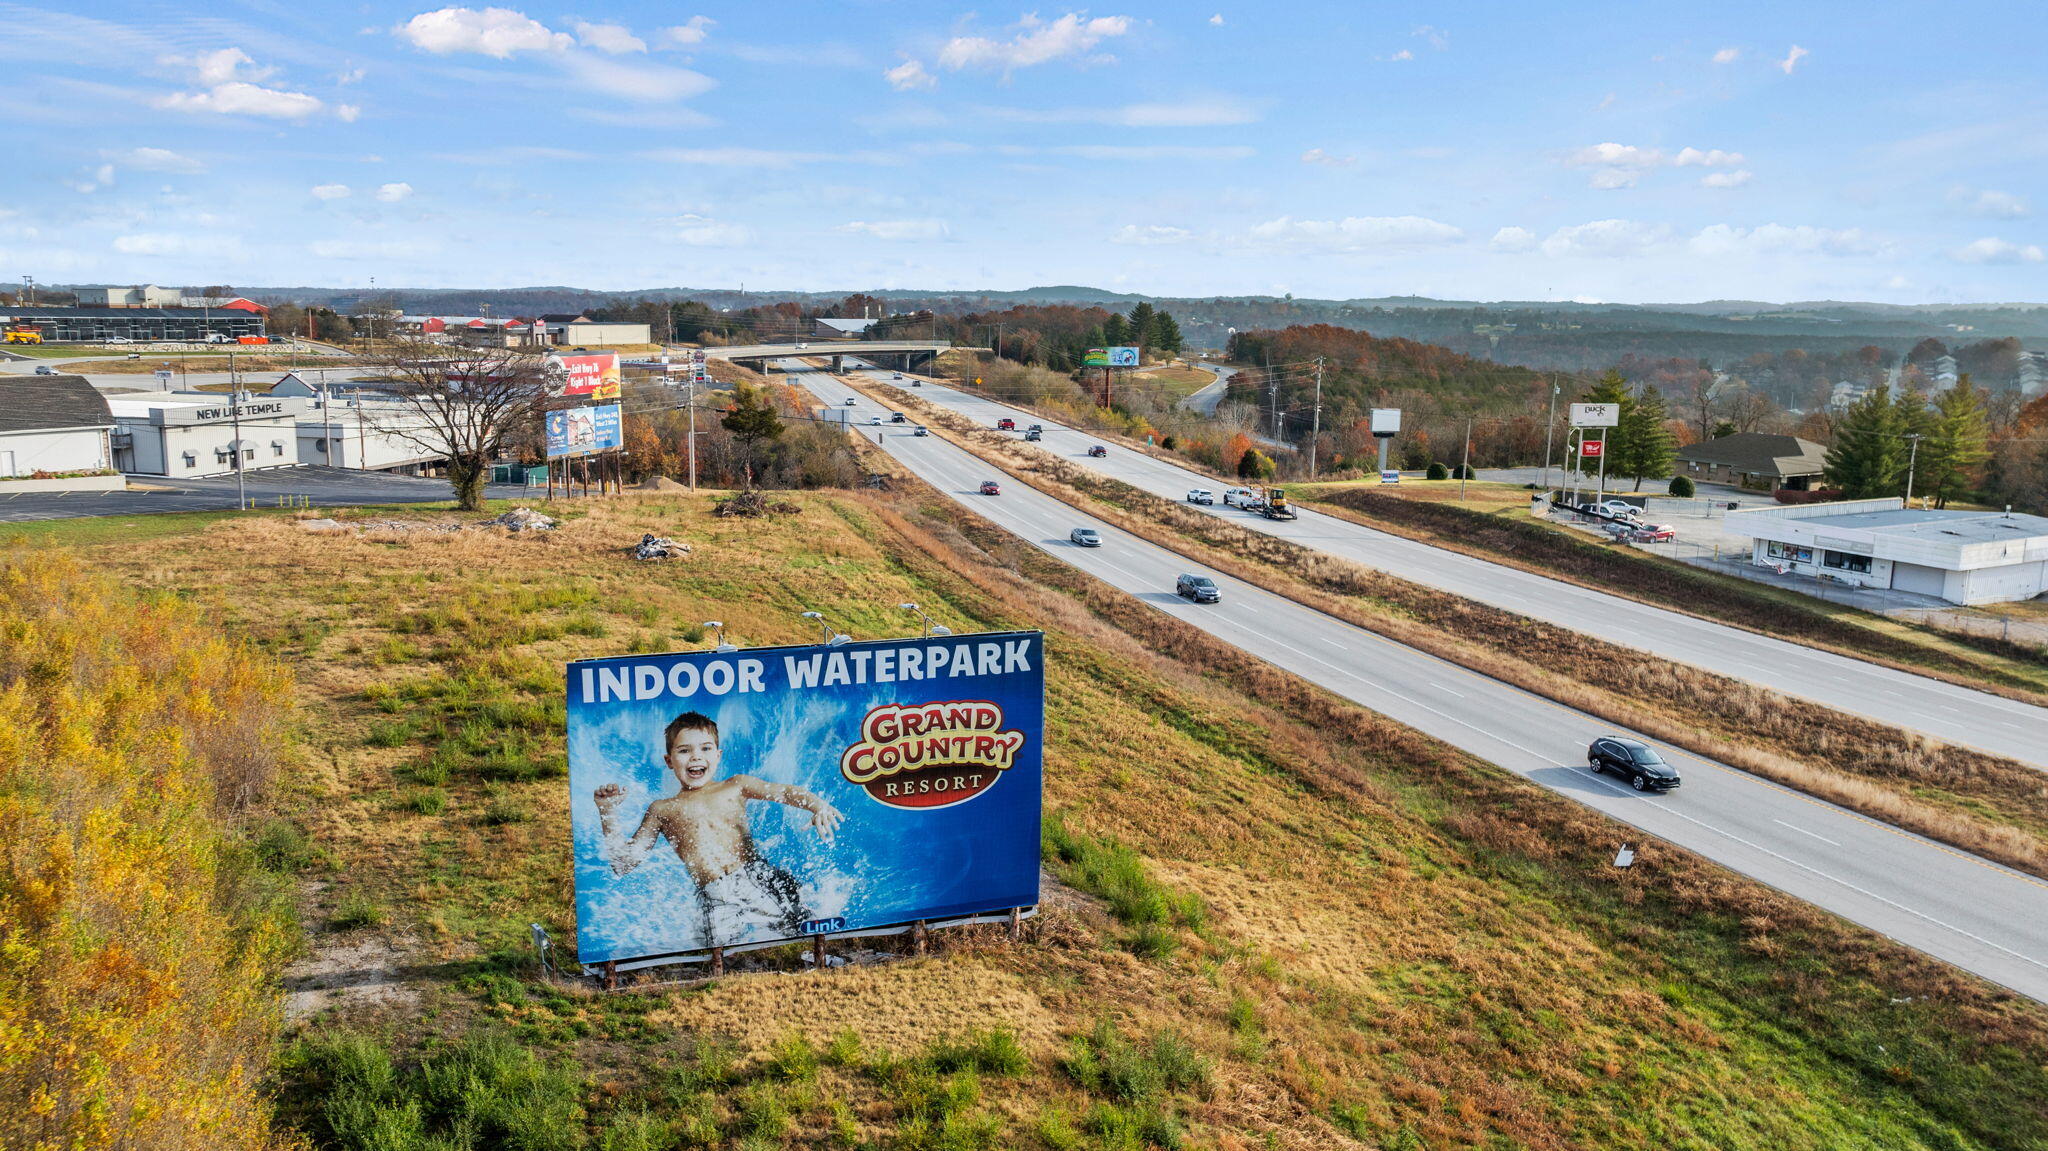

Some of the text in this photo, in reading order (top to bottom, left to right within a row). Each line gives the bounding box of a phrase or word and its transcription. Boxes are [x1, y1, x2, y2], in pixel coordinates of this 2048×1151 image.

[196, 408, 221, 420] NEW
[245, 403, 282, 415] TEMPLE
[581, 639, 1031, 703] INDOOR WATERPARK
[869, 708, 997, 744] GRAND
[848, 735, 1018, 777] COUNTRY
[885, 774, 983, 797] RESORT
[806, 918, 840, 933] Link
